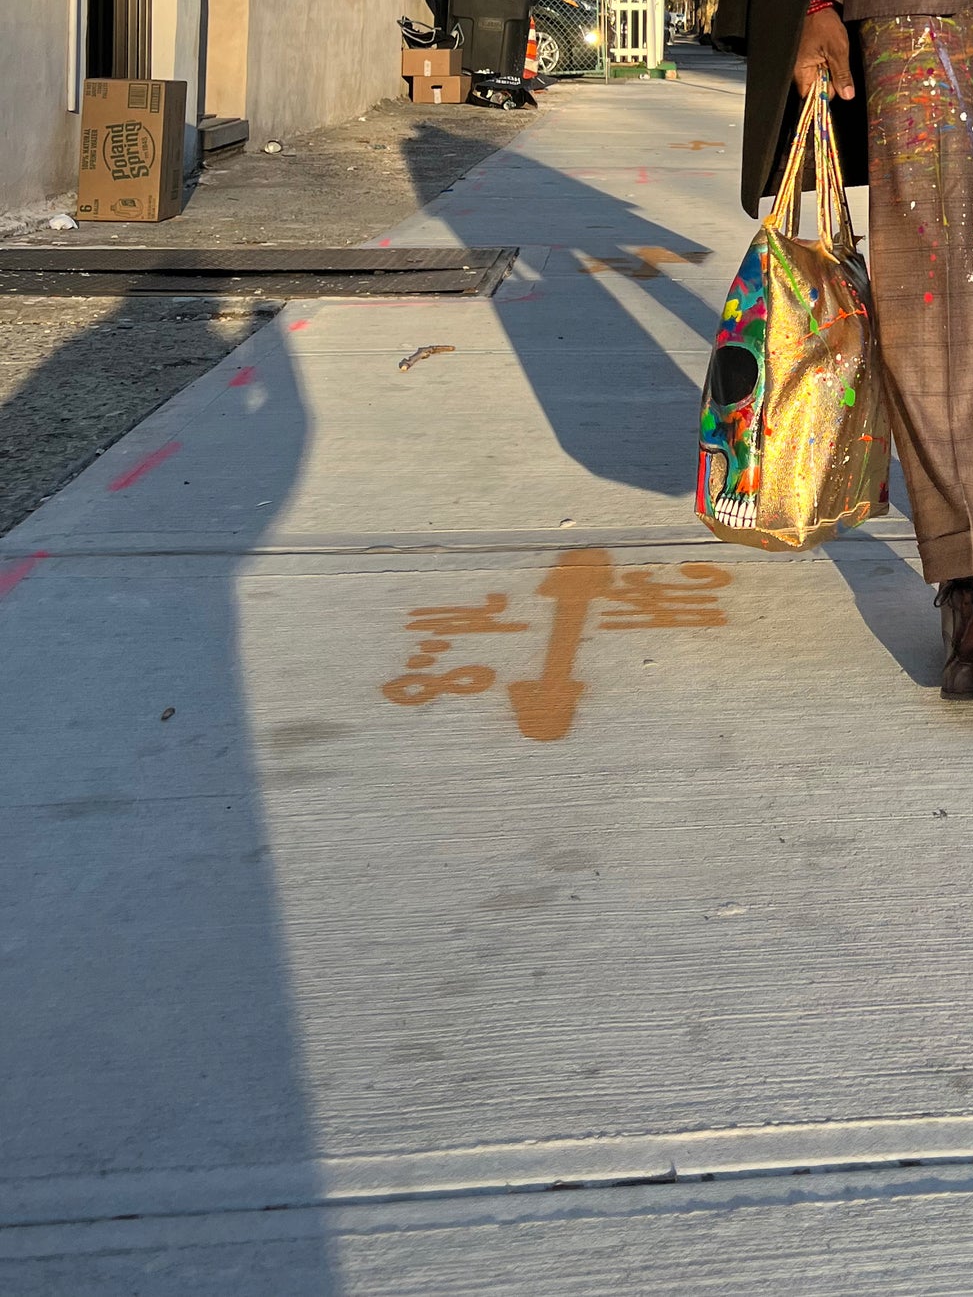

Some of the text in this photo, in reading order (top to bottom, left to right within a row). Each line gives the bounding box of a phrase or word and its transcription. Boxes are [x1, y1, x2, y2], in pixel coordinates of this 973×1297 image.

[105, 123, 131, 181] Poland
[124, 122, 149, 179] Spring
[80, 204, 92, 213] 6
